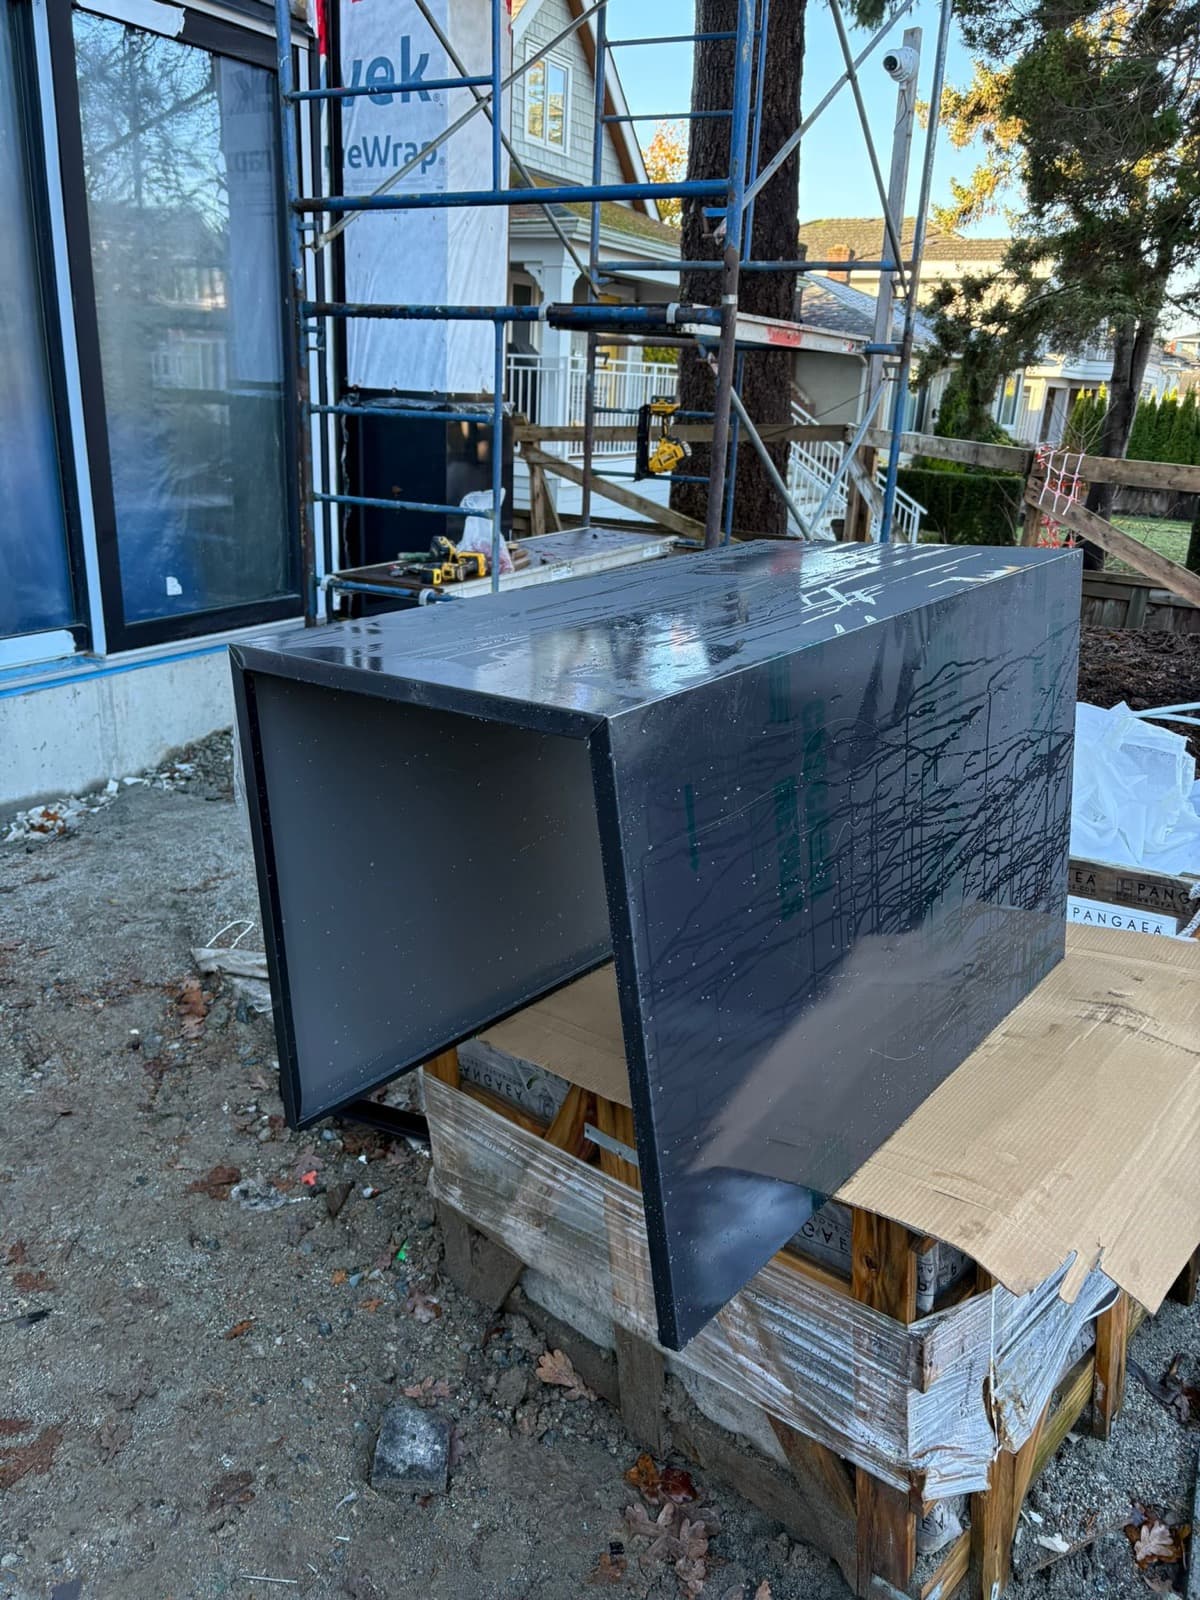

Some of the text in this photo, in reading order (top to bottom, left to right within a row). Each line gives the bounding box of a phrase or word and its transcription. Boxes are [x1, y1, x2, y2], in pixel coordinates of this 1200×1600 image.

[342, 35, 432, 107] vek
[343, 135, 438, 174] eWrap
[1137, 883, 1191, 904] PANG
[1073, 907, 1162, 935] PANGAEA
